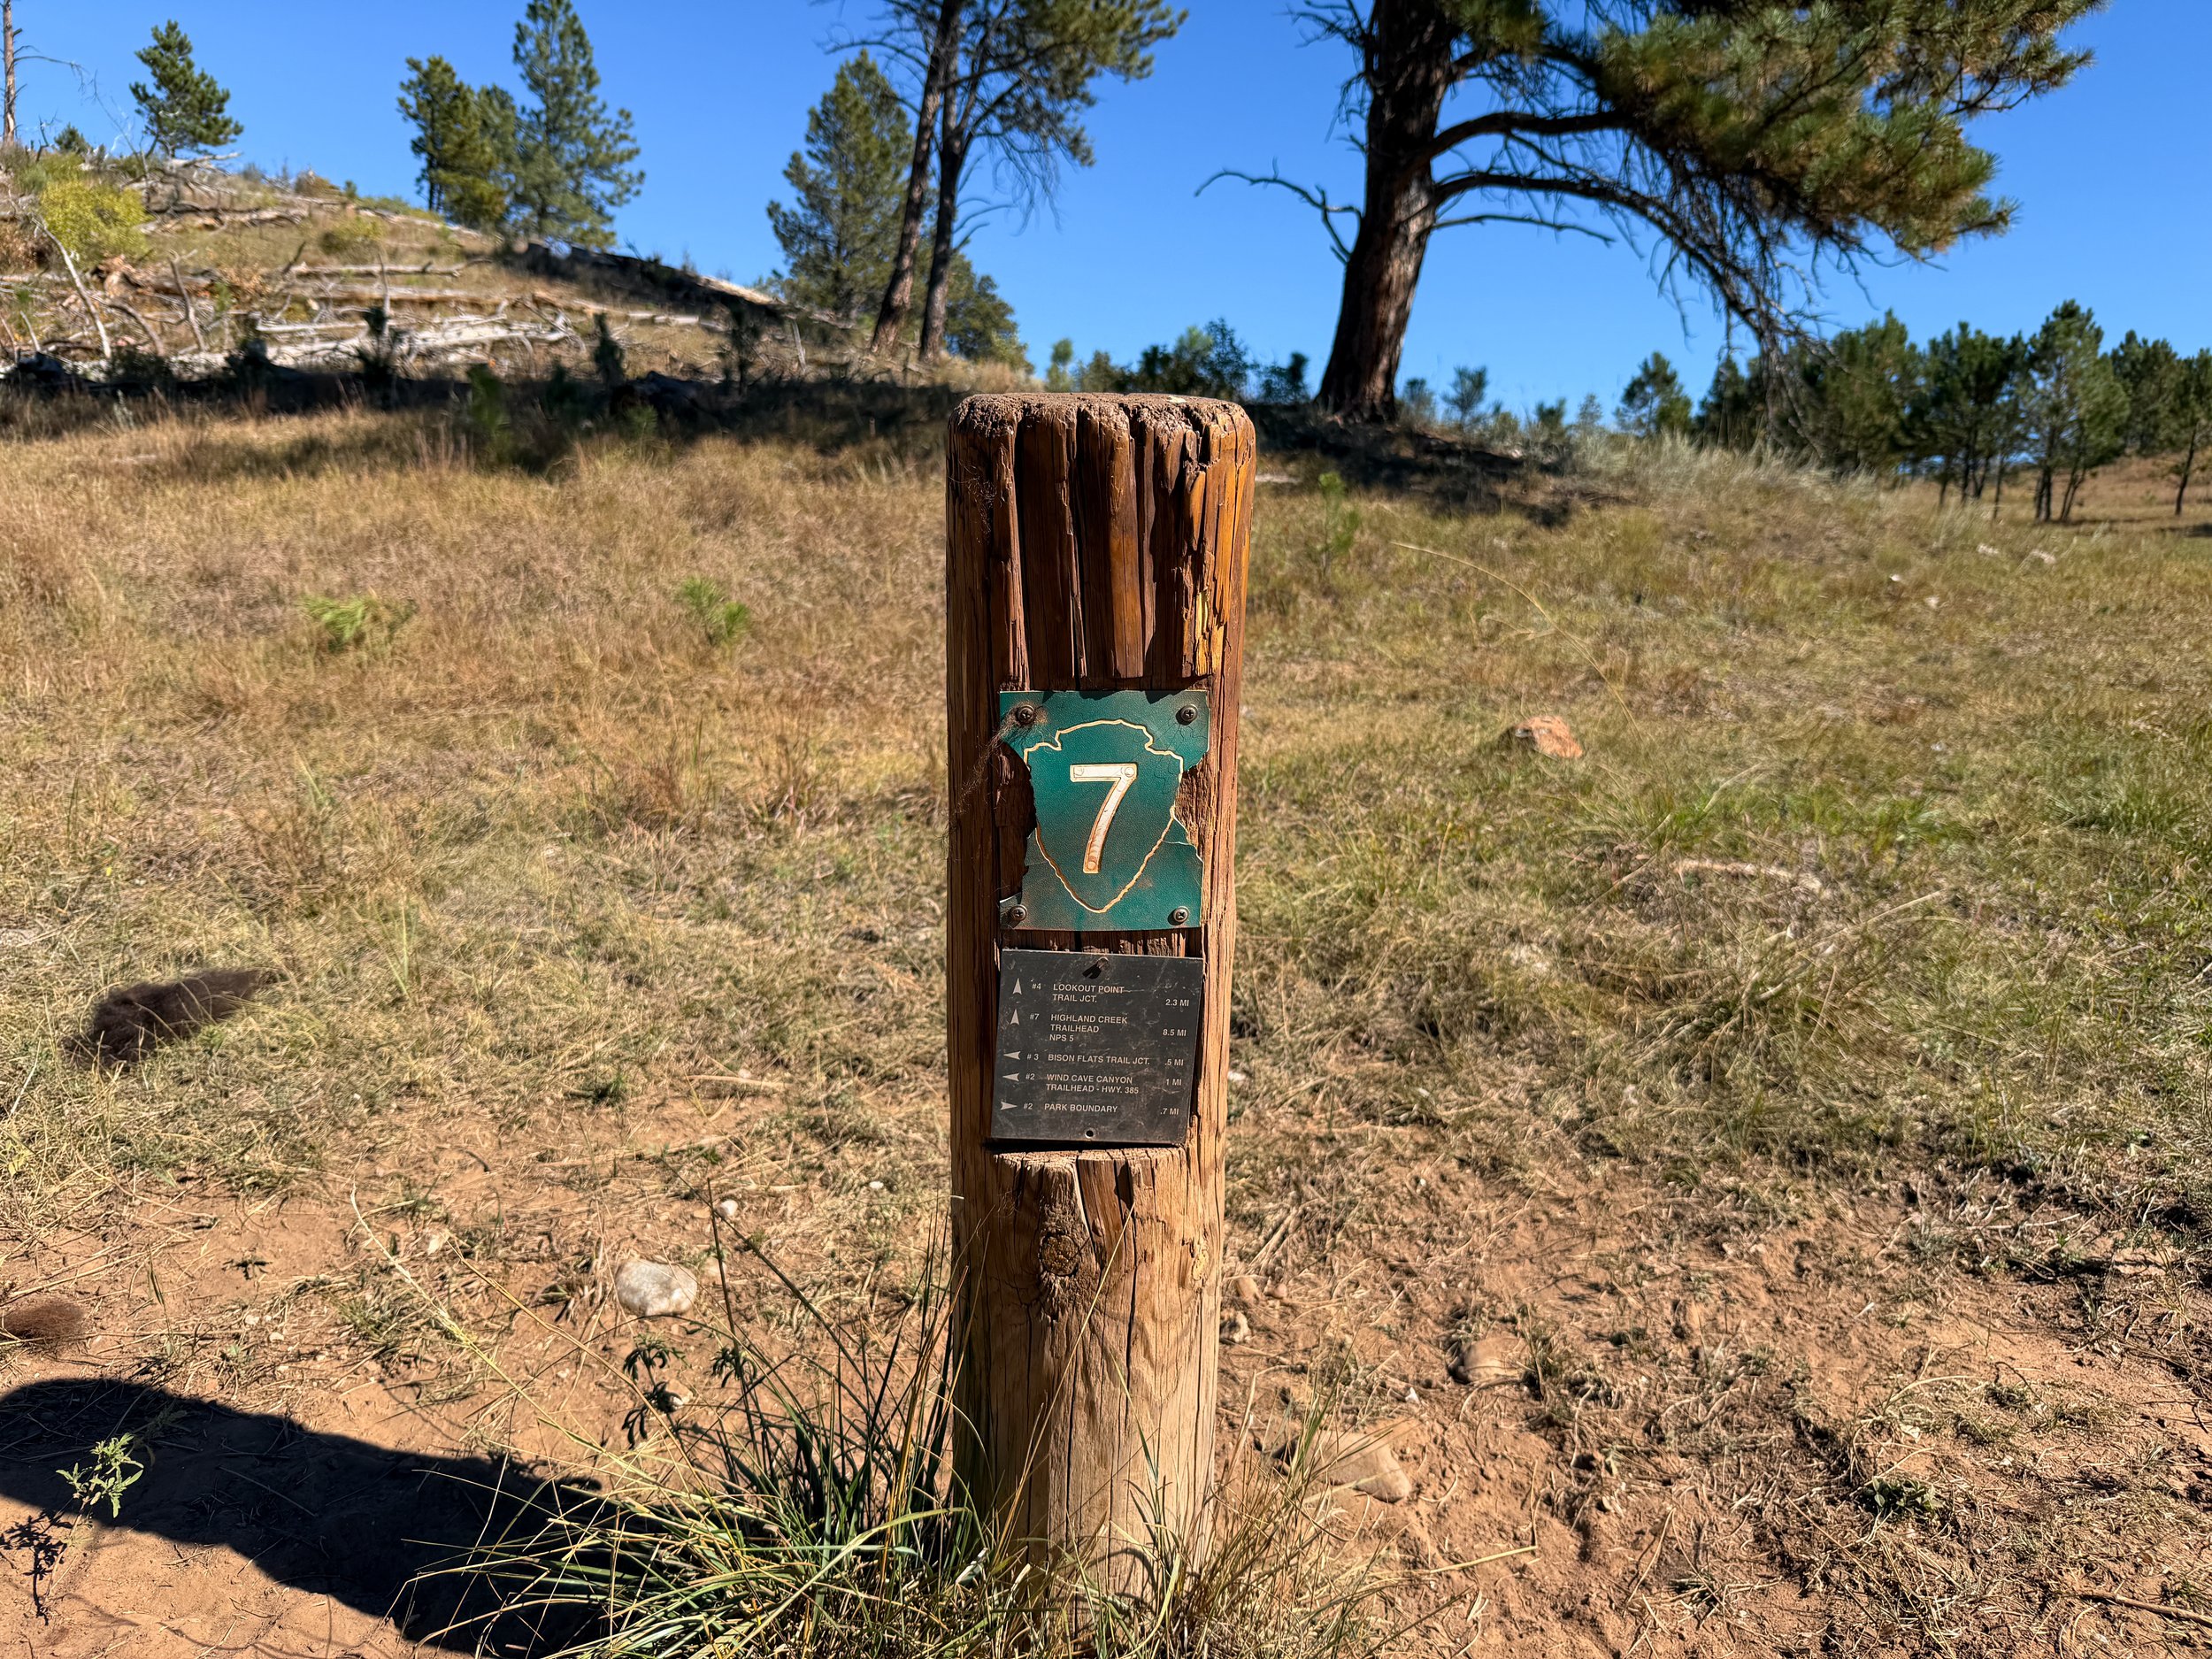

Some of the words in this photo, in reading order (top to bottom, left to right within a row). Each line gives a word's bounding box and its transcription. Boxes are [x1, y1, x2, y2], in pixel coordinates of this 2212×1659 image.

[1070, 764, 1137, 873] 7
[1053, 984, 1096, 993] LOOKOUT
[1051, 1014, 1096, 1023] HIGHLAND
[1133, 1056, 1150, 1065] JCT.
[1096, 1075, 1133, 1084] CANYON
